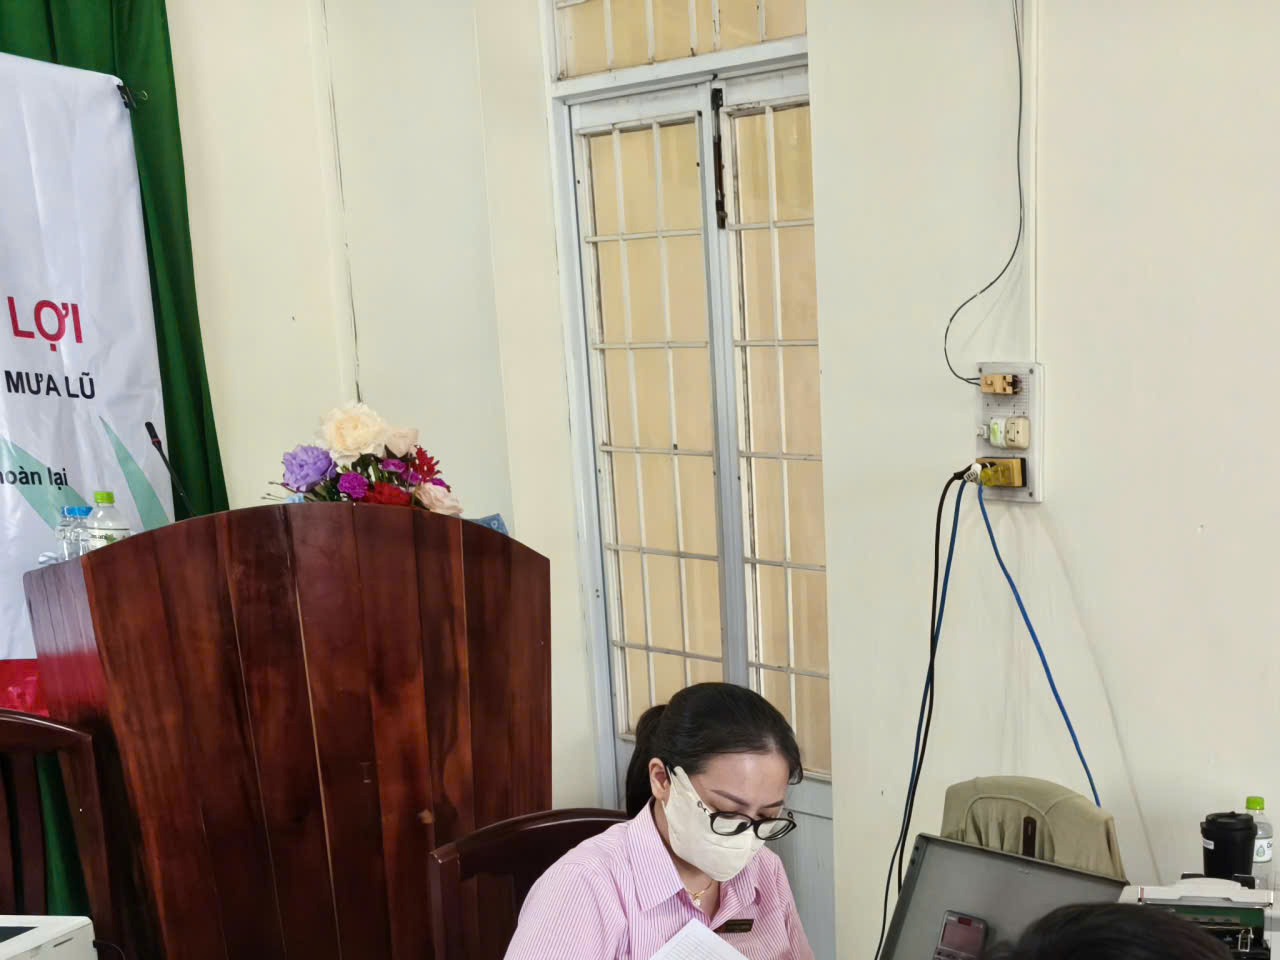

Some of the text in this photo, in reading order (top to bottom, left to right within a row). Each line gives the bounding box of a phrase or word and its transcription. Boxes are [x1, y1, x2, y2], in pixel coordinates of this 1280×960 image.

[7, 296, 83, 352] LỢI
[4, 370, 95, 399] MƯA LŨ
[47, 466, 68, 491] lại
